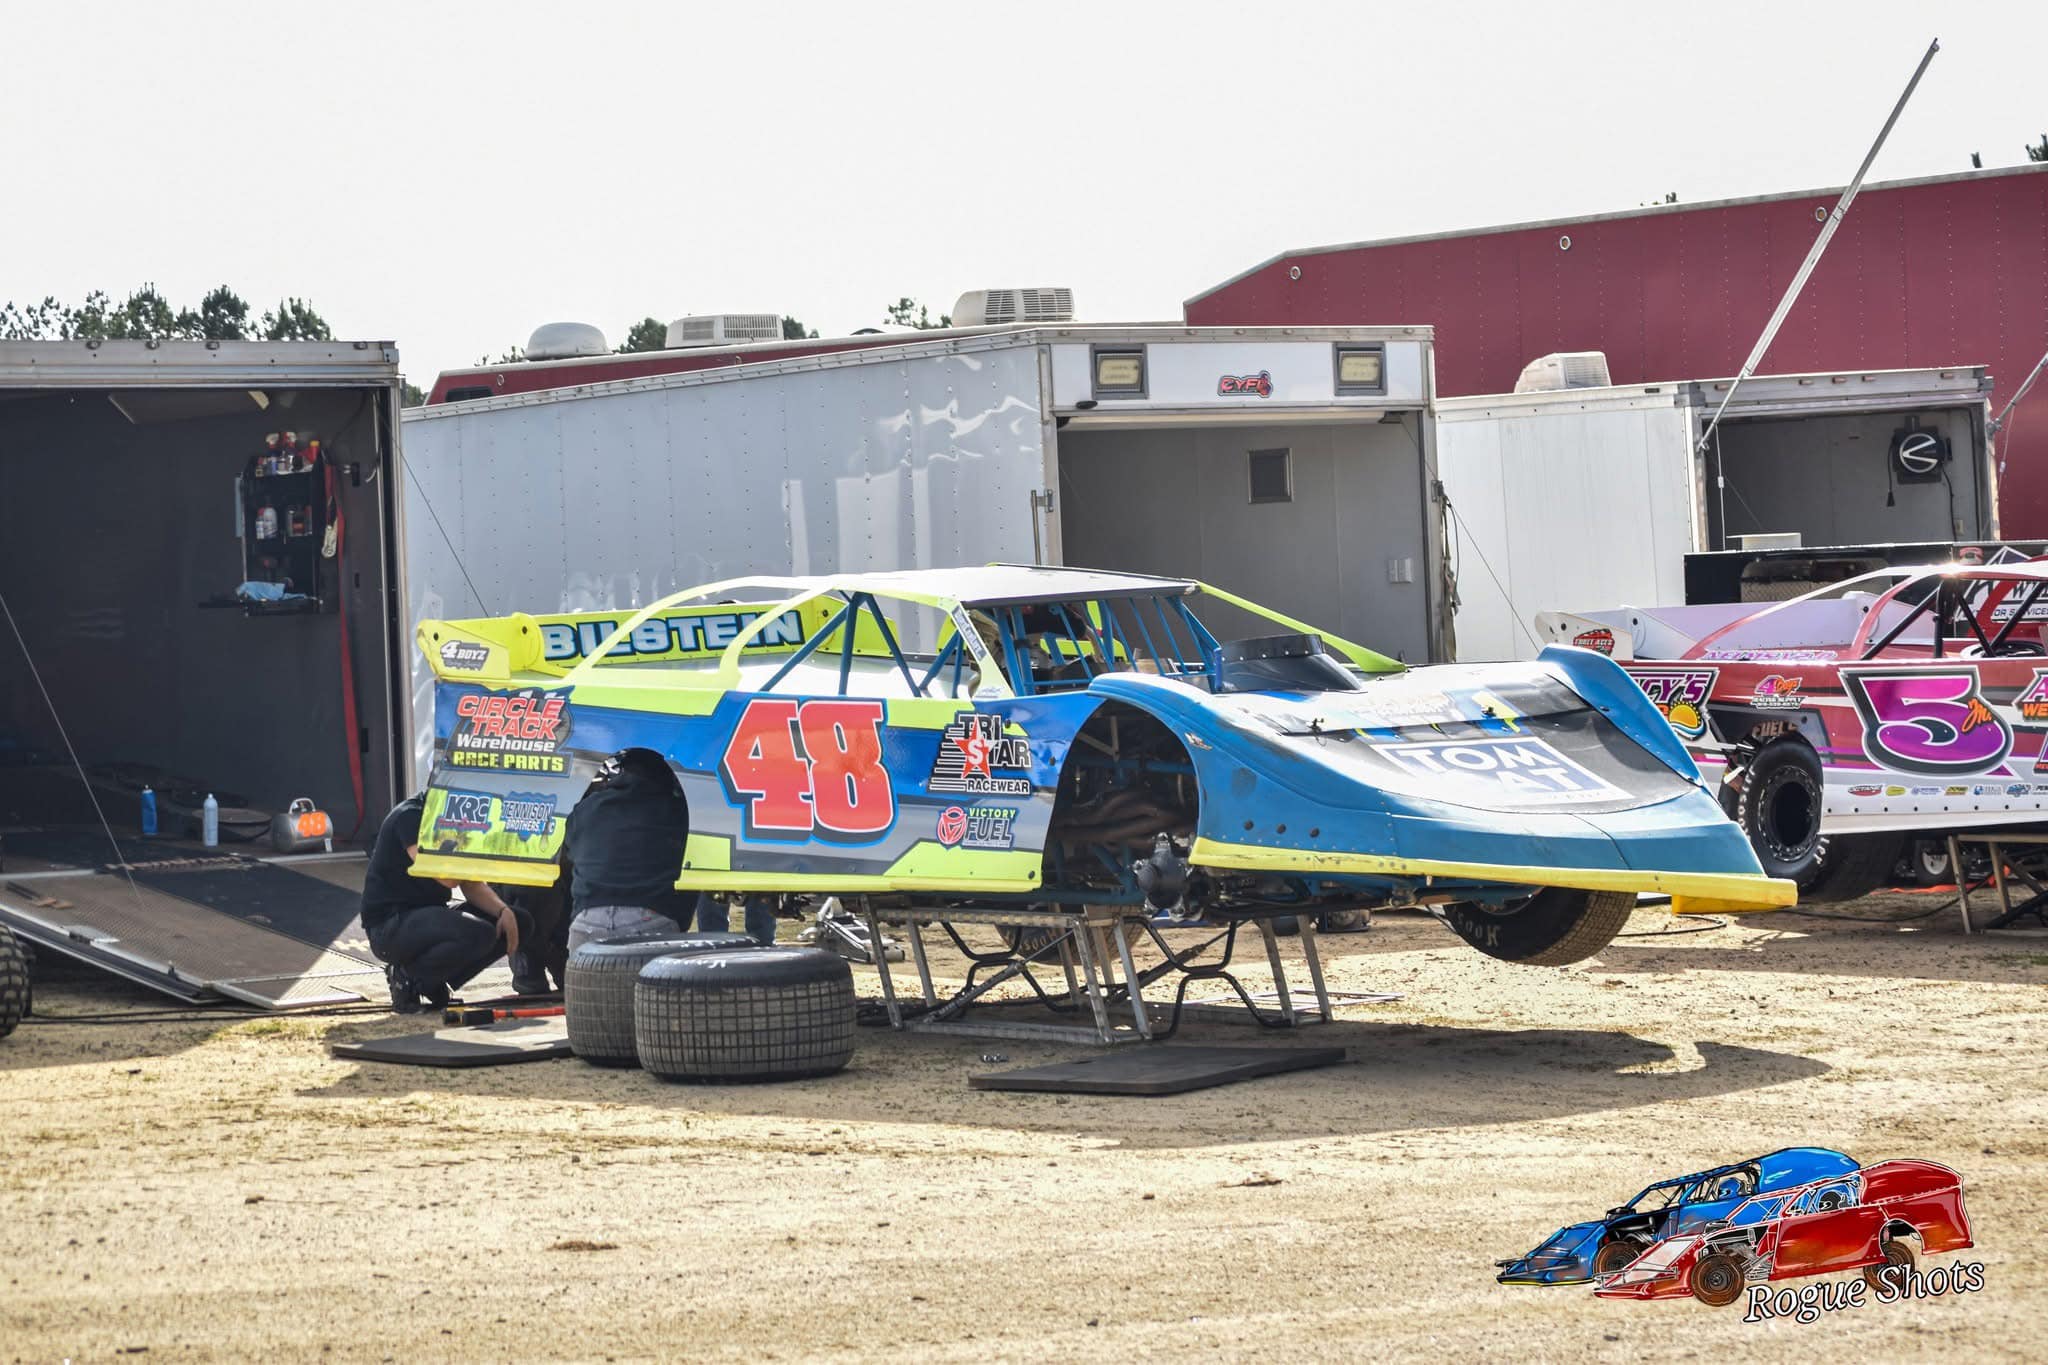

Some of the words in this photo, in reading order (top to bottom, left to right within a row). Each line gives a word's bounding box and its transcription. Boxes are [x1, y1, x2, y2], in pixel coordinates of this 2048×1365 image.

[538, 609, 805, 661] BILSTEIN
[441, 640, 461, 659] 4
[456, 648, 488, 661] BOYZ
[457, 695, 566, 720] CIRCLE
[1858, 673, 2007, 765] 5
[472, 715, 561, 740] TRACK
[957, 713, 1002, 742] TRI
[457, 734, 556, 752] Warehouse
[452, 750, 500, 768] RACE
[503, 753, 565, 772] PARTS
[723, 699, 895, 833] 48
[1394, 743, 1562, 773] TOM
[966, 778, 1031, 795] RACEWEAR
[1496, 766, 1587, 792] AT
[444, 793, 492, 825] KRC
[502, 800, 555, 821] TENNISON
[968, 806, 1017, 819] VICTORY
[296, 810, 328, 838] 48
[963, 816, 1013, 842] FUEL
